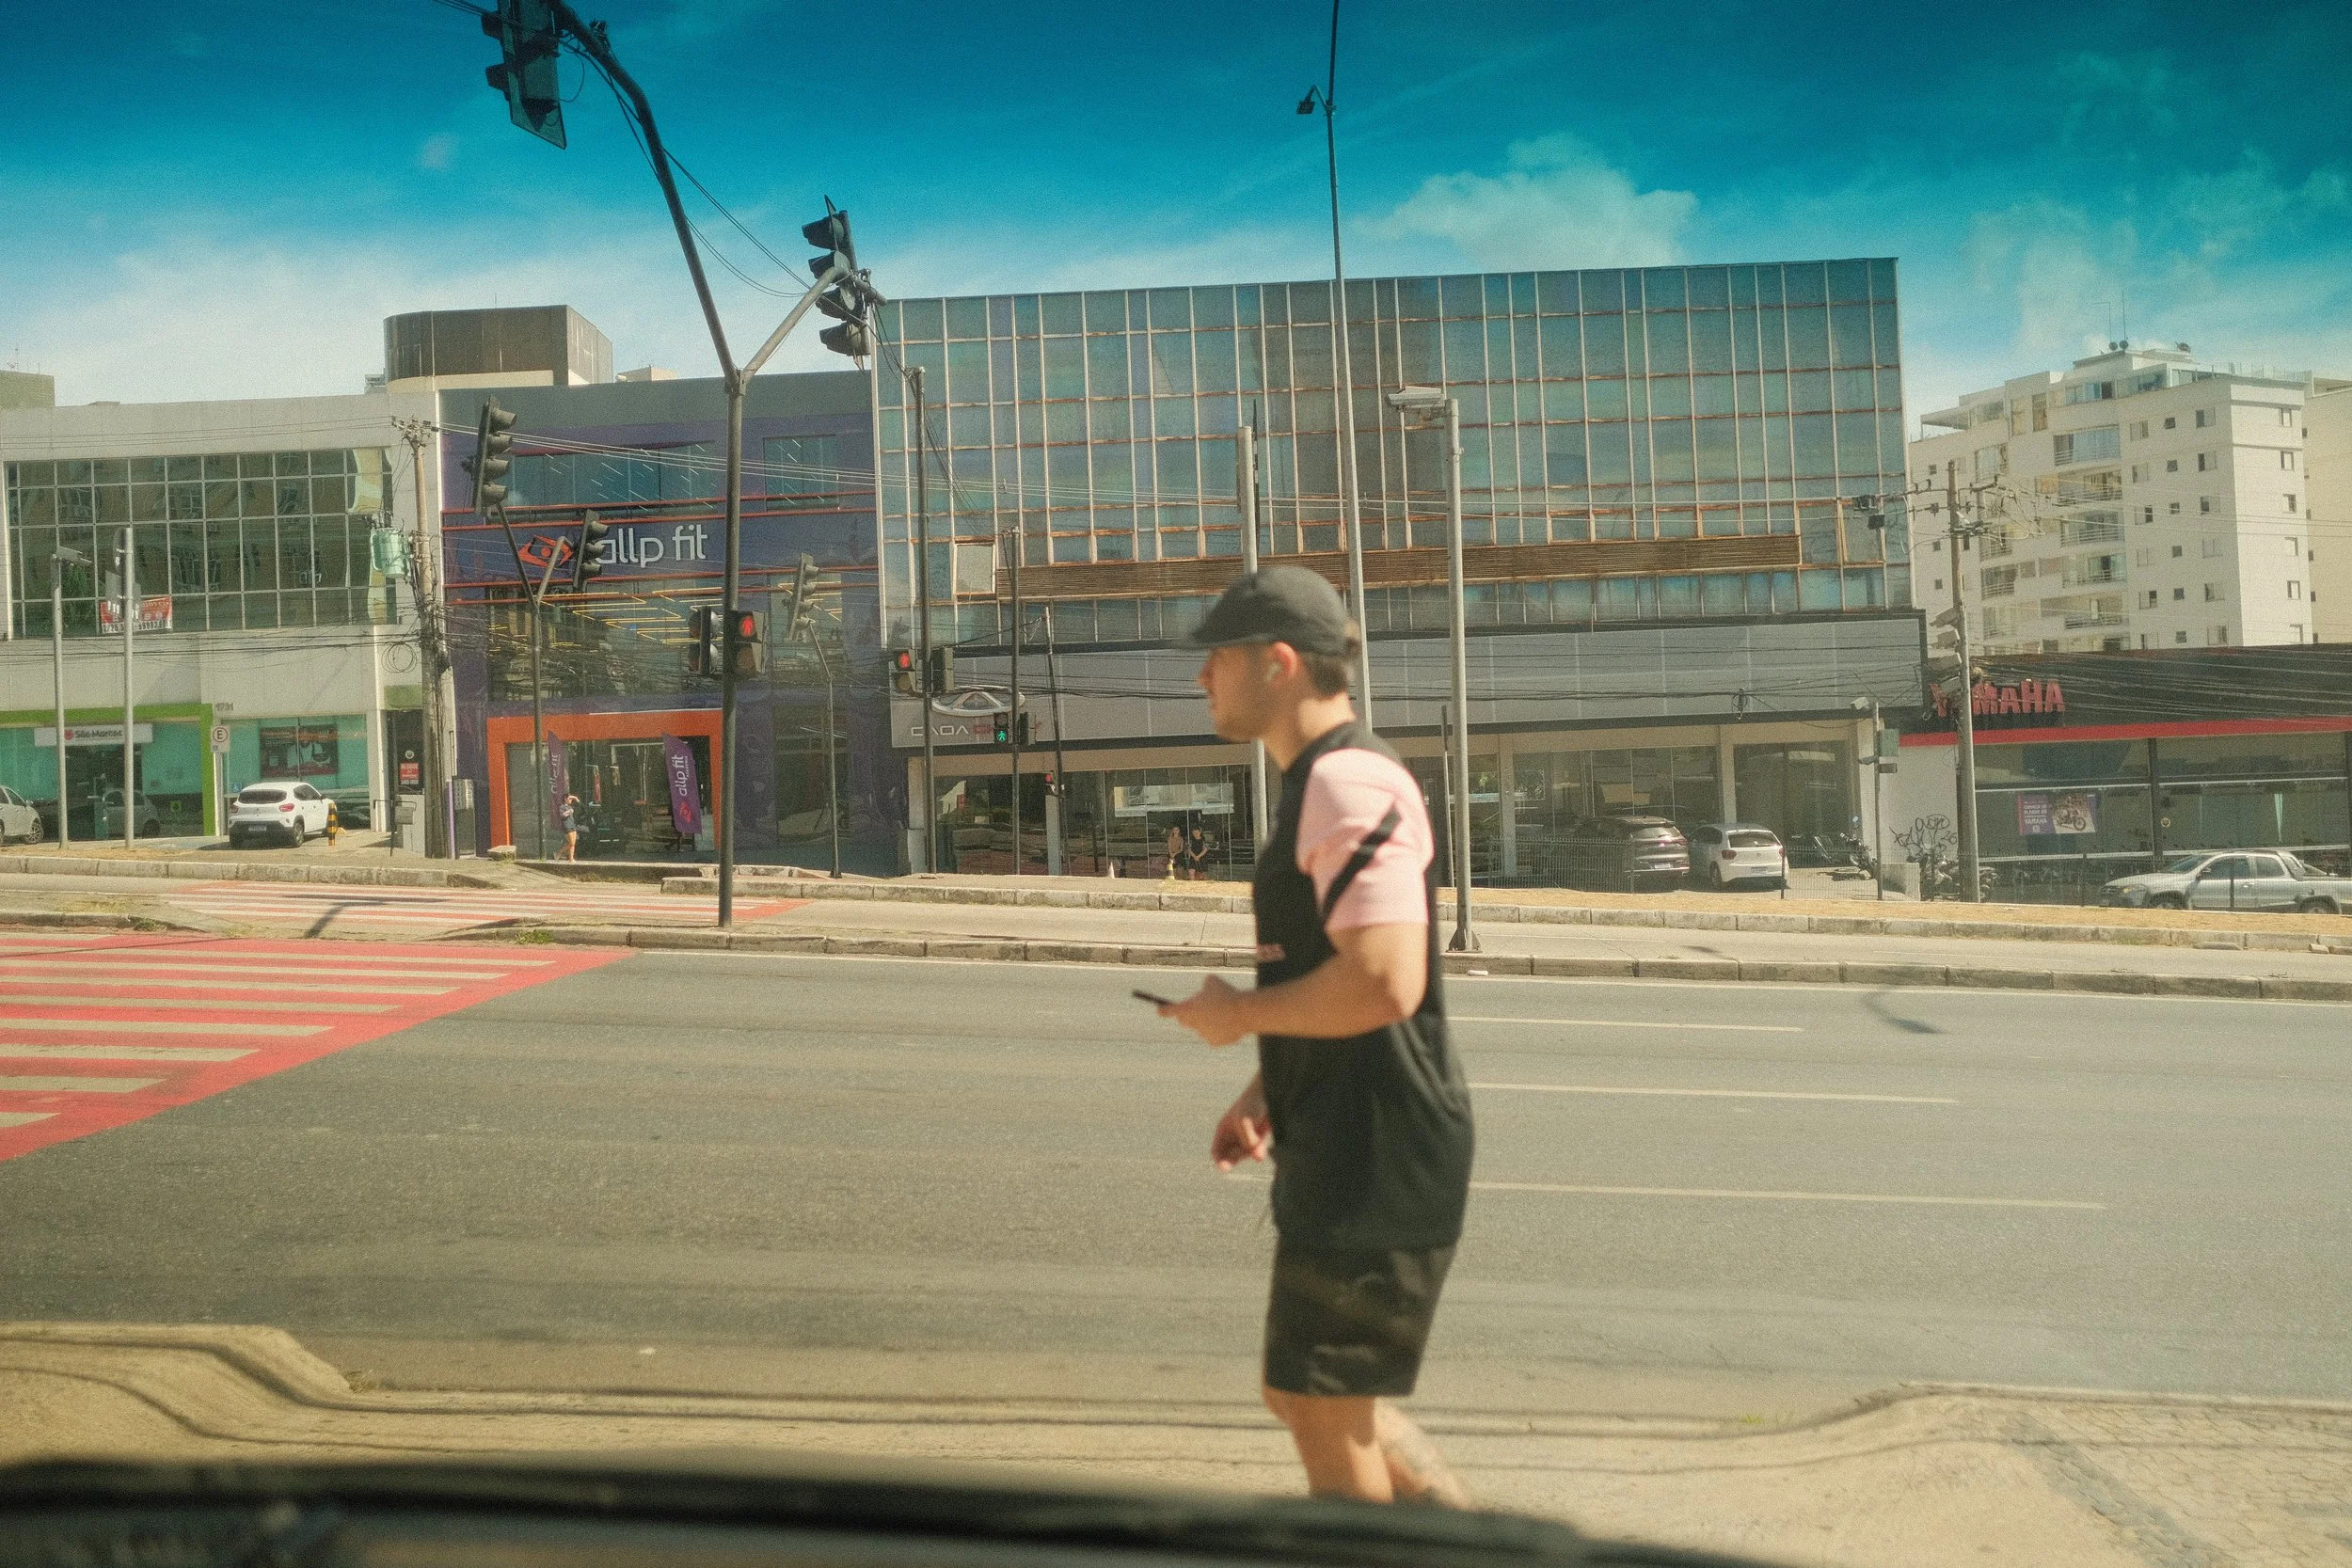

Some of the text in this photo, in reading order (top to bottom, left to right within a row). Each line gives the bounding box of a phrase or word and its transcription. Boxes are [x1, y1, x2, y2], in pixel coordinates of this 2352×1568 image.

[594, 524, 708, 568] allp fit
[1929, 678, 2066, 718] YMAHA
[217, 730, 223, 740] E
[671, 754, 688, 797] allp fit
